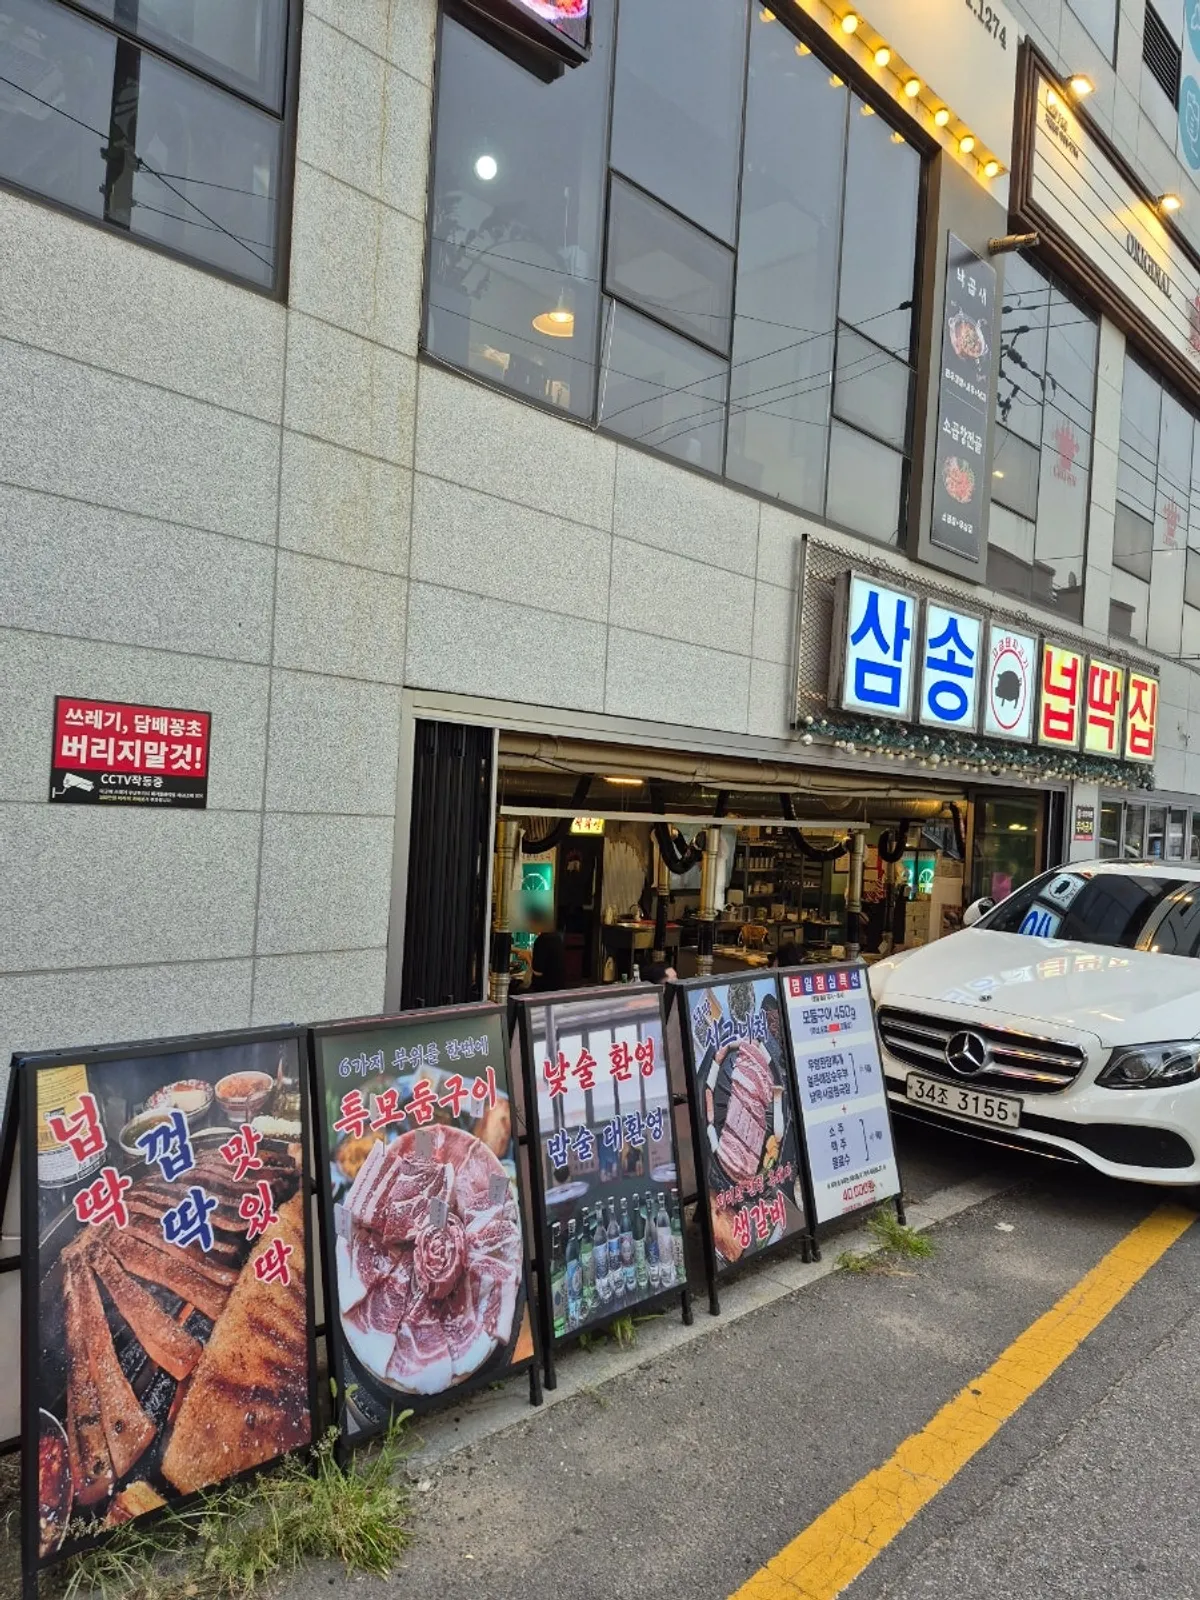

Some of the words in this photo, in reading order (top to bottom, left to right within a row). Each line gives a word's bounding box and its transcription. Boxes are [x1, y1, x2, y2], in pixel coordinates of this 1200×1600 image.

[1126, 231, 1172, 299] ORIGINAL
[943, 417, 983, 455] 소곱창전골
[851, 590, 975, 721] 삼송
[1043, 650, 1156, 756] 넙딱집
[65, 707, 128, 734] 쓰레기,
[134, 713, 203, 737] 담배꽁초
[61, 734, 202, 771] 버리지말것!
[100, 773, 164, 788] CCTV작동중
[338, 1050, 385, 1078] 6가지
[391, 1041, 441, 1071] 부위를
[445, 1035, 490, 1061] 한번에
[542, 1047, 598, 1098] 낮술
[608, 1037, 656, 1083] 환영
[332, 1065, 497, 1139] 특모둠구이
[914, 1080, 949, 1106] 34조
[957, 1091, 1009, 1121] 3155
[547, 1124, 596, 1169] 밤술
[602, 1106, 665, 1153] 대환영
[733, 1189, 787, 1248] 생갈비
